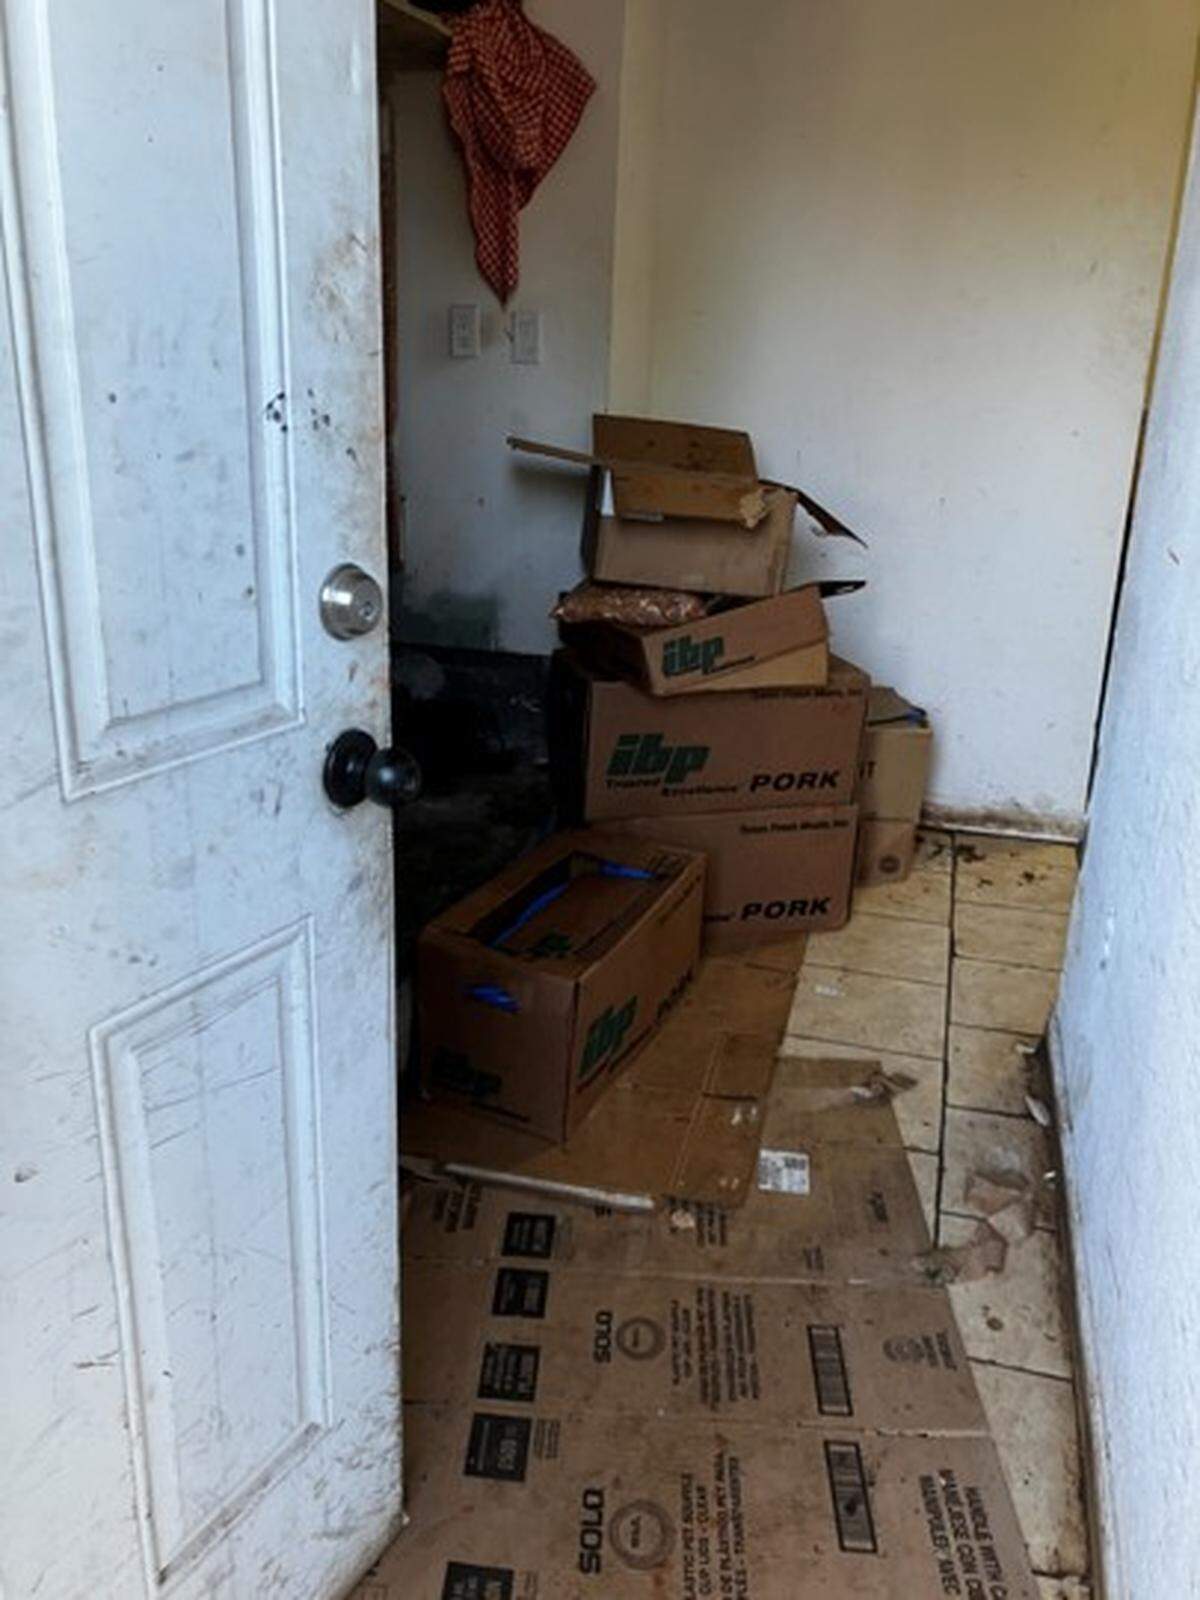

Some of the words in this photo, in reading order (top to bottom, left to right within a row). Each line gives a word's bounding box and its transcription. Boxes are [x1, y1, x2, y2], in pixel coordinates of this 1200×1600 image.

[662, 636, 724, 676] ibp
[606, 733, 711, 784] ibp
[750, 770, 840, 792] PORK
[741, 897, 830, 920] PORK
[593, 1310, 614, 1364] SOLO
[579, 1487, 605, 1574] SOLO
[682, 1553, 697, 1600] LASTIC
